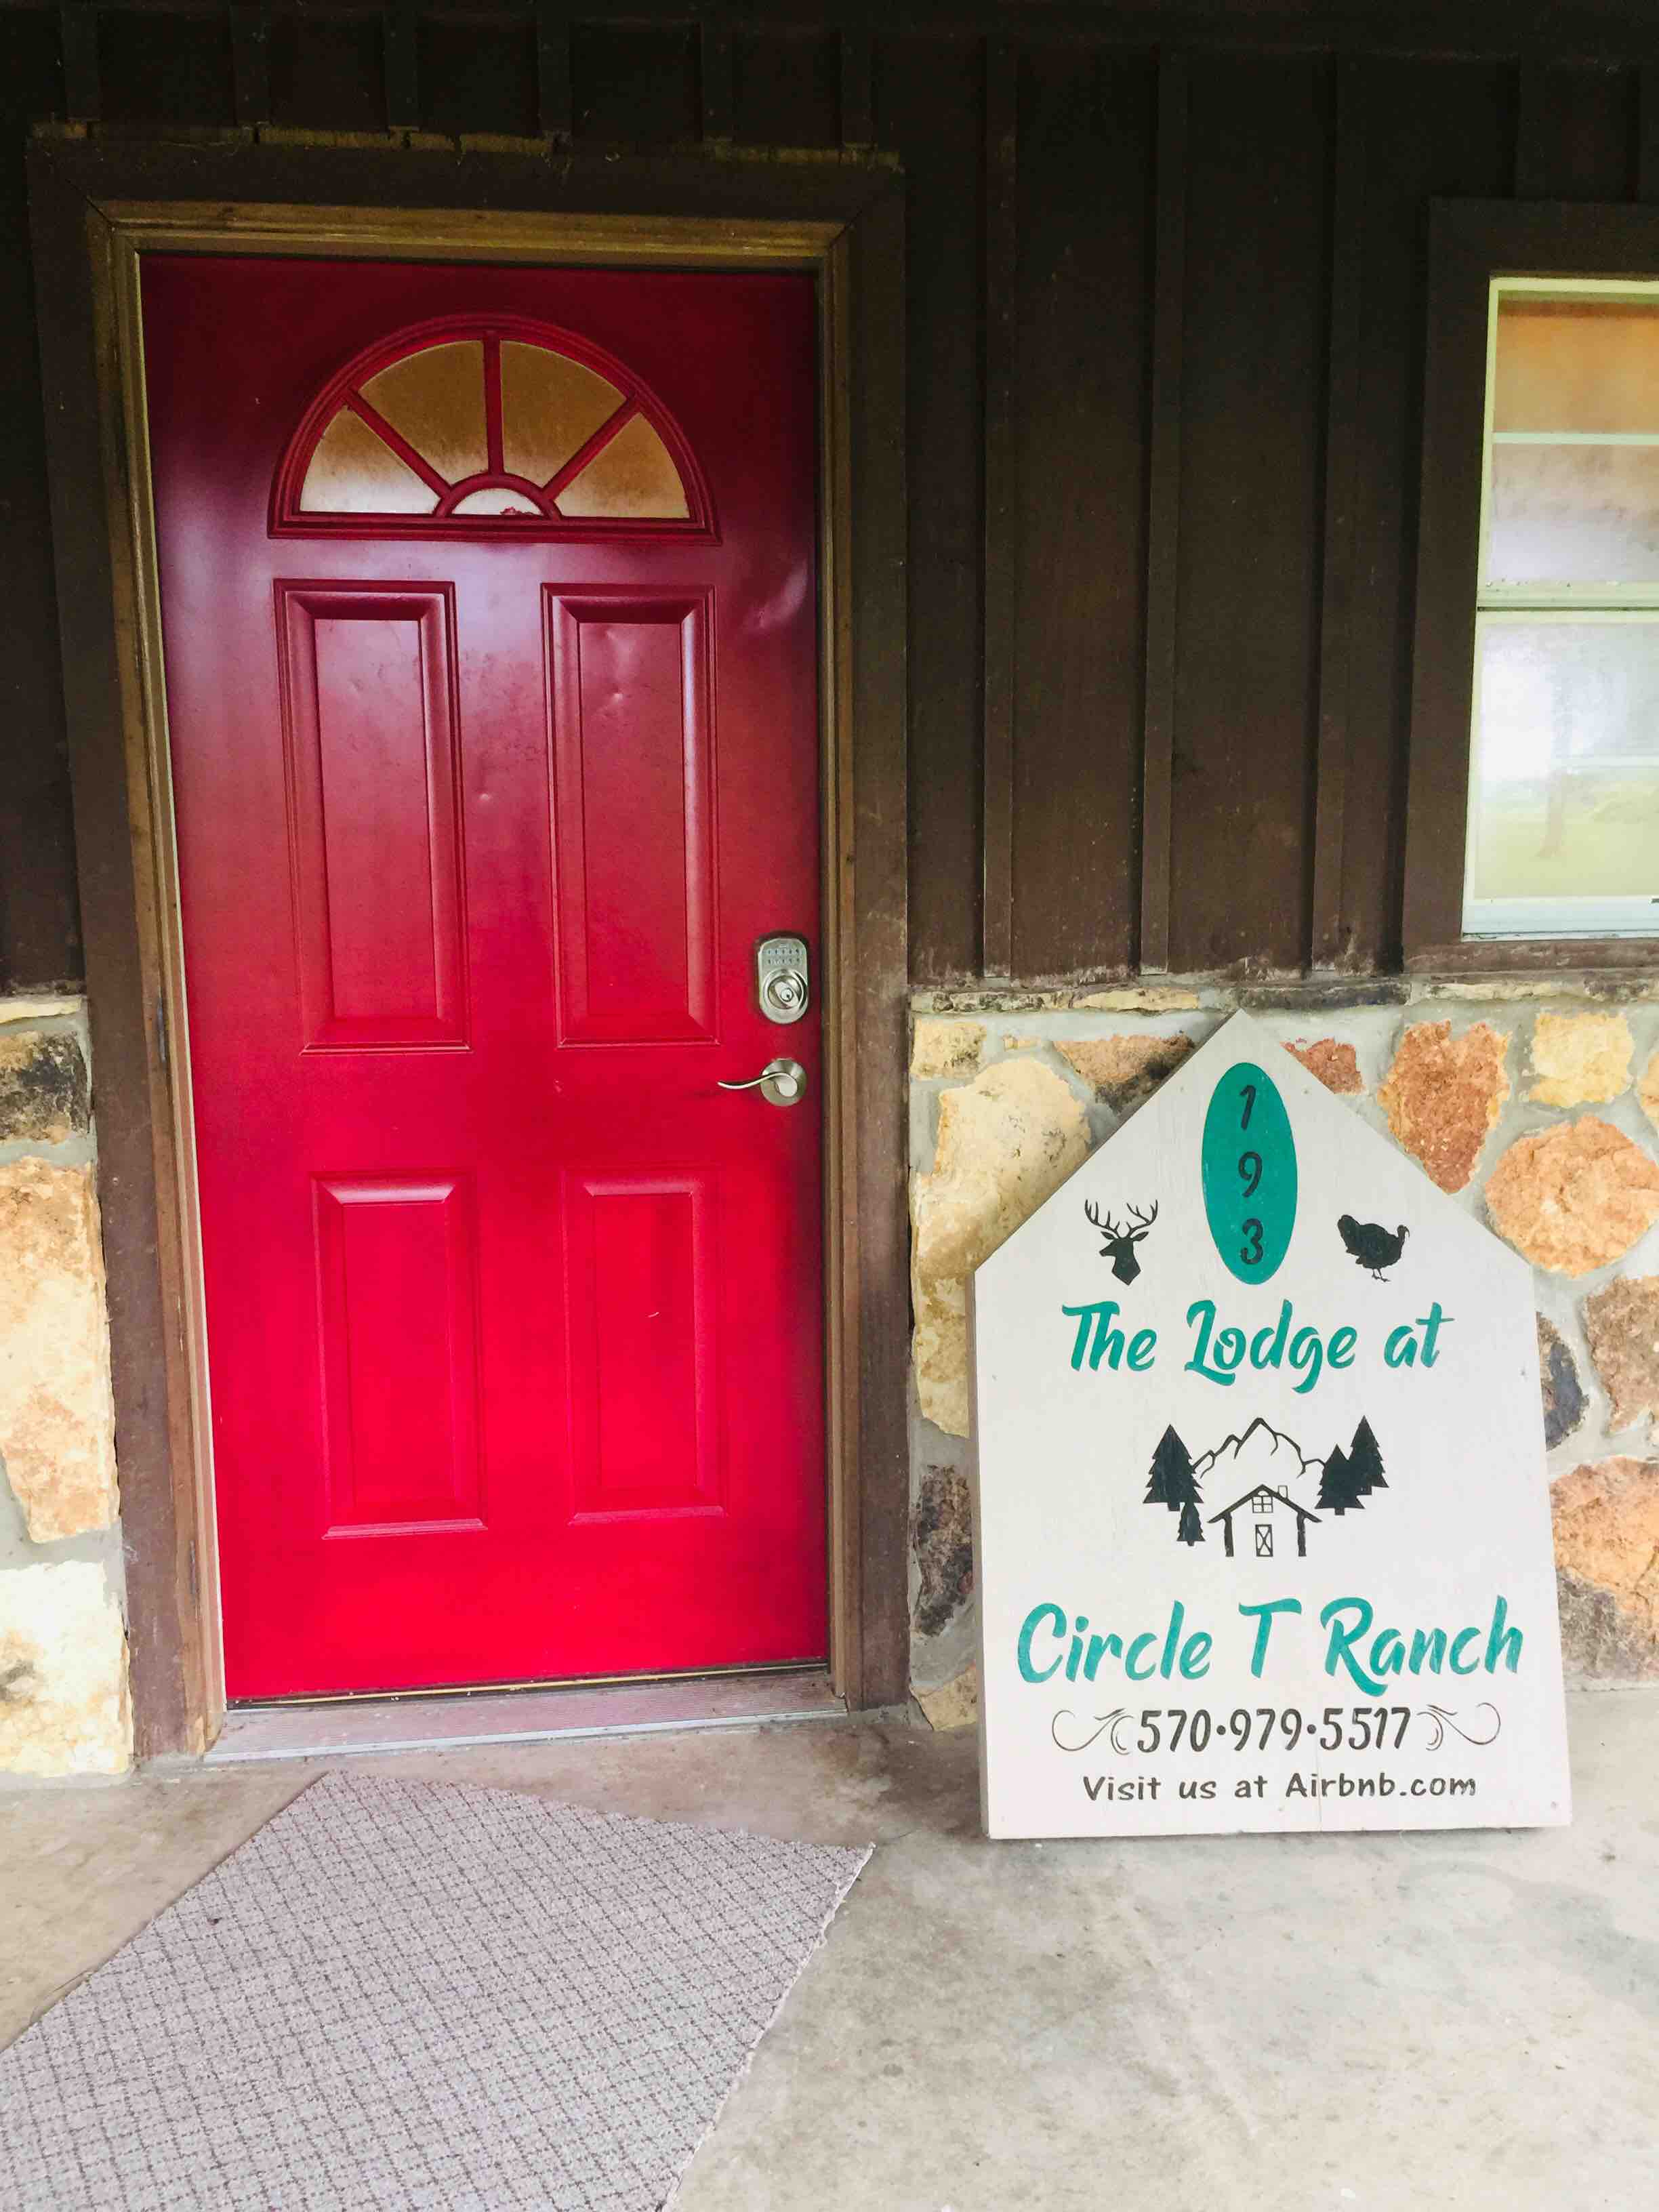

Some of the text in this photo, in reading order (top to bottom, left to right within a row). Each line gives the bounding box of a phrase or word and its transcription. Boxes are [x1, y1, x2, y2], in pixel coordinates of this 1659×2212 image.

[1061, 1300, 1456, 1395] The Lodge at
[1018, 1595, 1523, 1697] Circle T Ranch
[1083, 1771, 1477, 1801] Visit us at Airbnb.com
